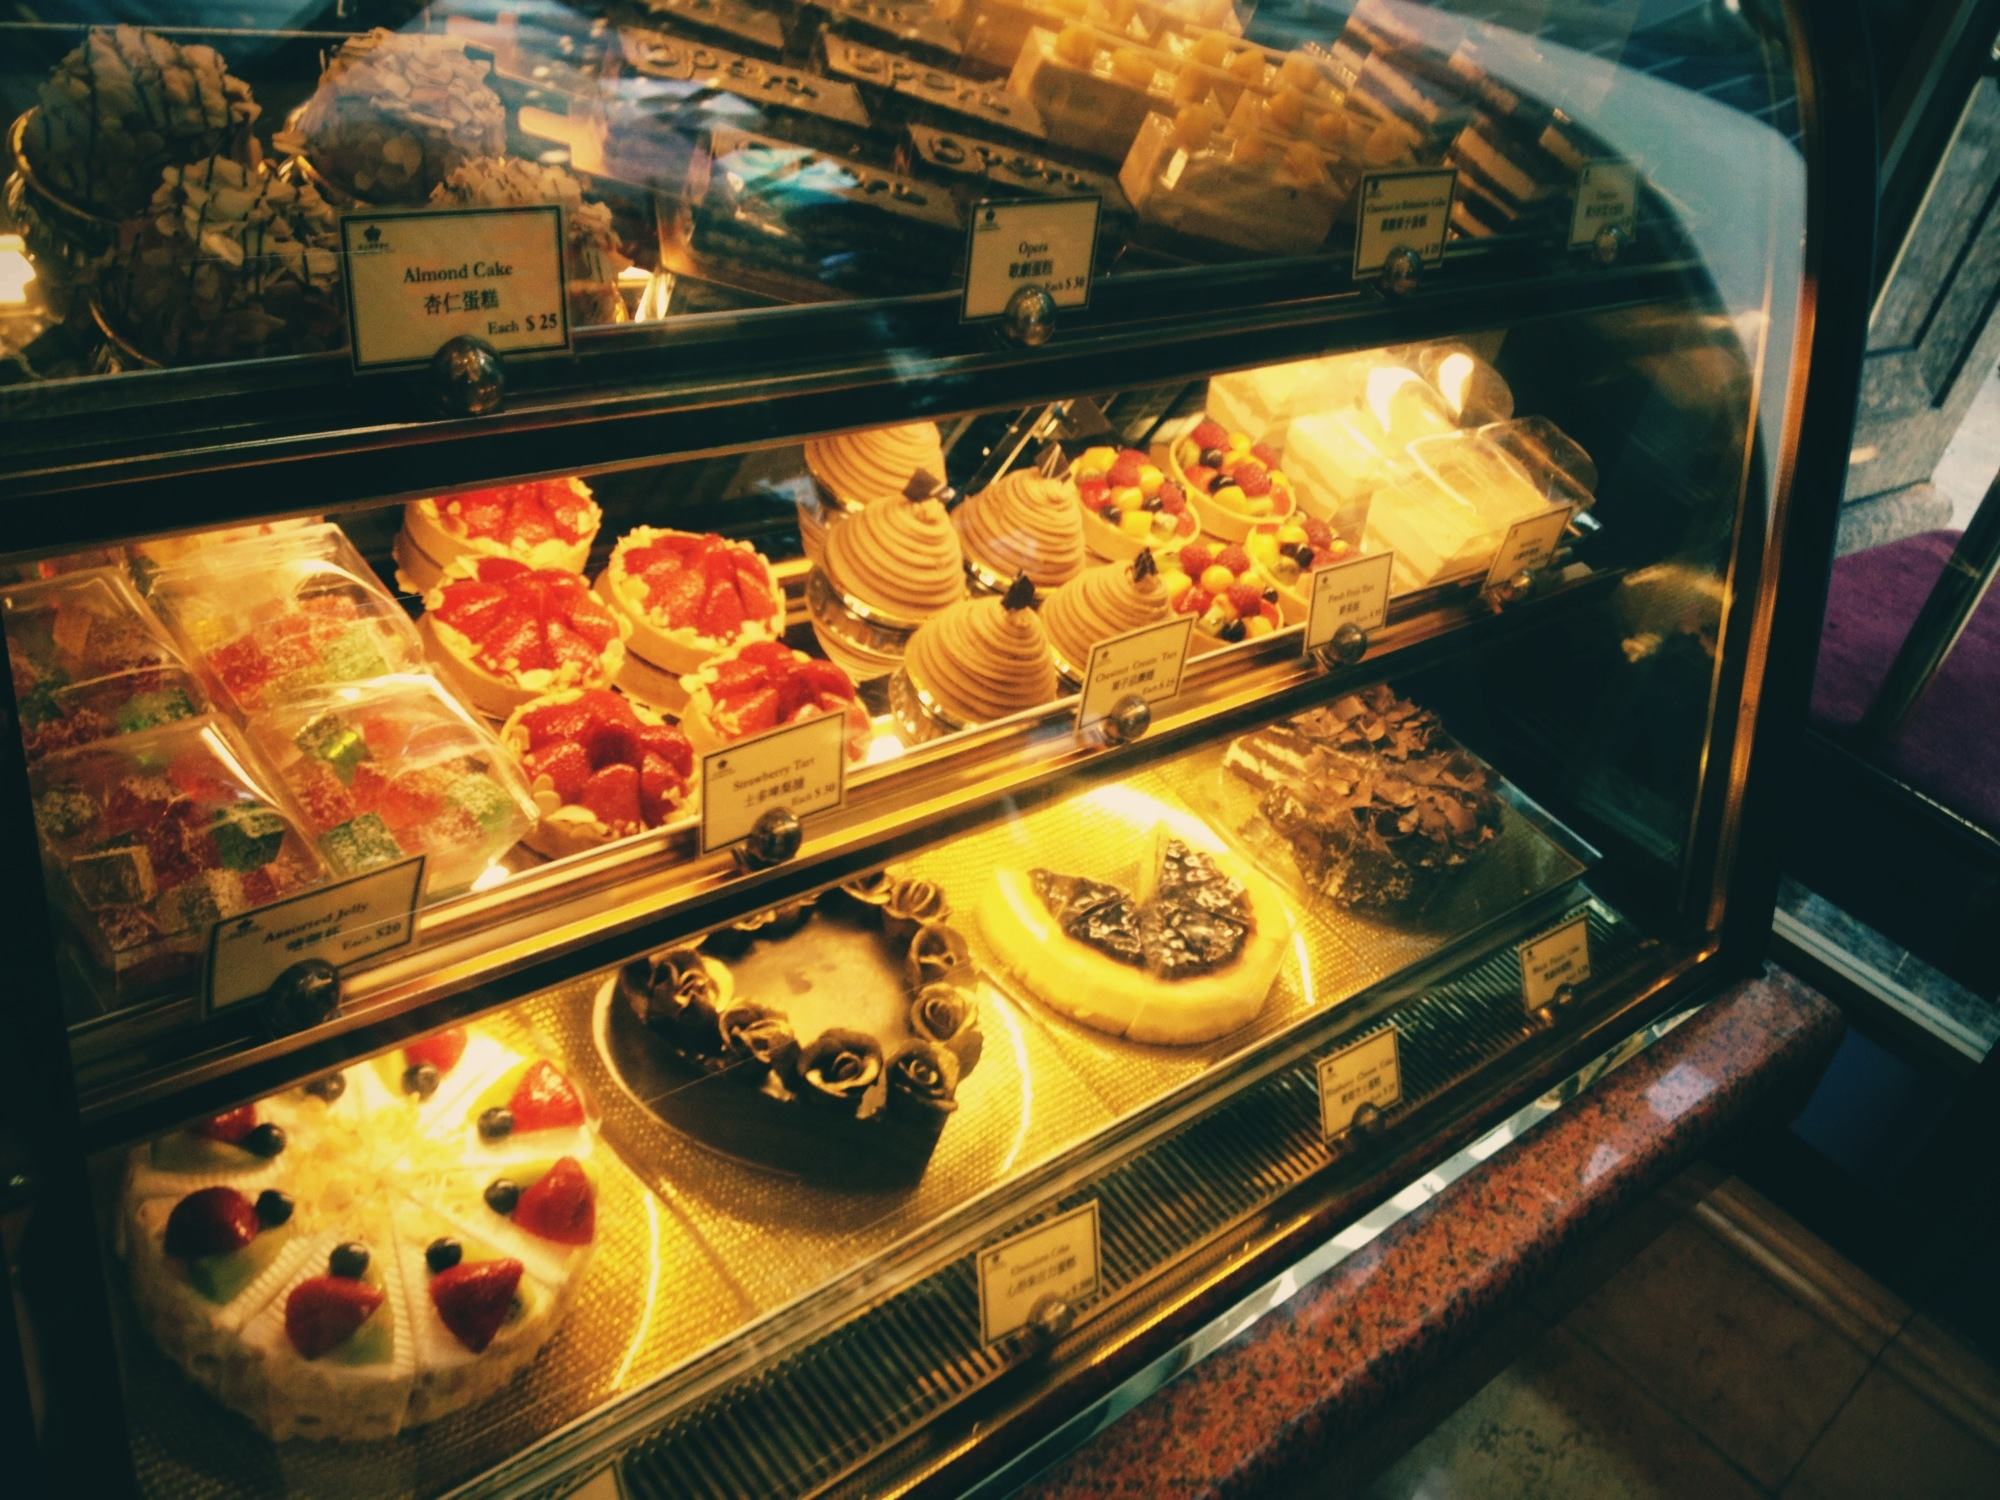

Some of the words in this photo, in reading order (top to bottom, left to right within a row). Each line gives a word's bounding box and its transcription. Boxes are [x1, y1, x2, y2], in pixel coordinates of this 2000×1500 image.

[403, 263, 469, 283] Almond
[473, 261, 513, 278] Cake
[424, 289, 500, 315] 杏仁蛋糕
[488, 320, 520, 335] Each
[263, 913, 333, 944] Assorted
[336, 902, 369, 922] Jelly
